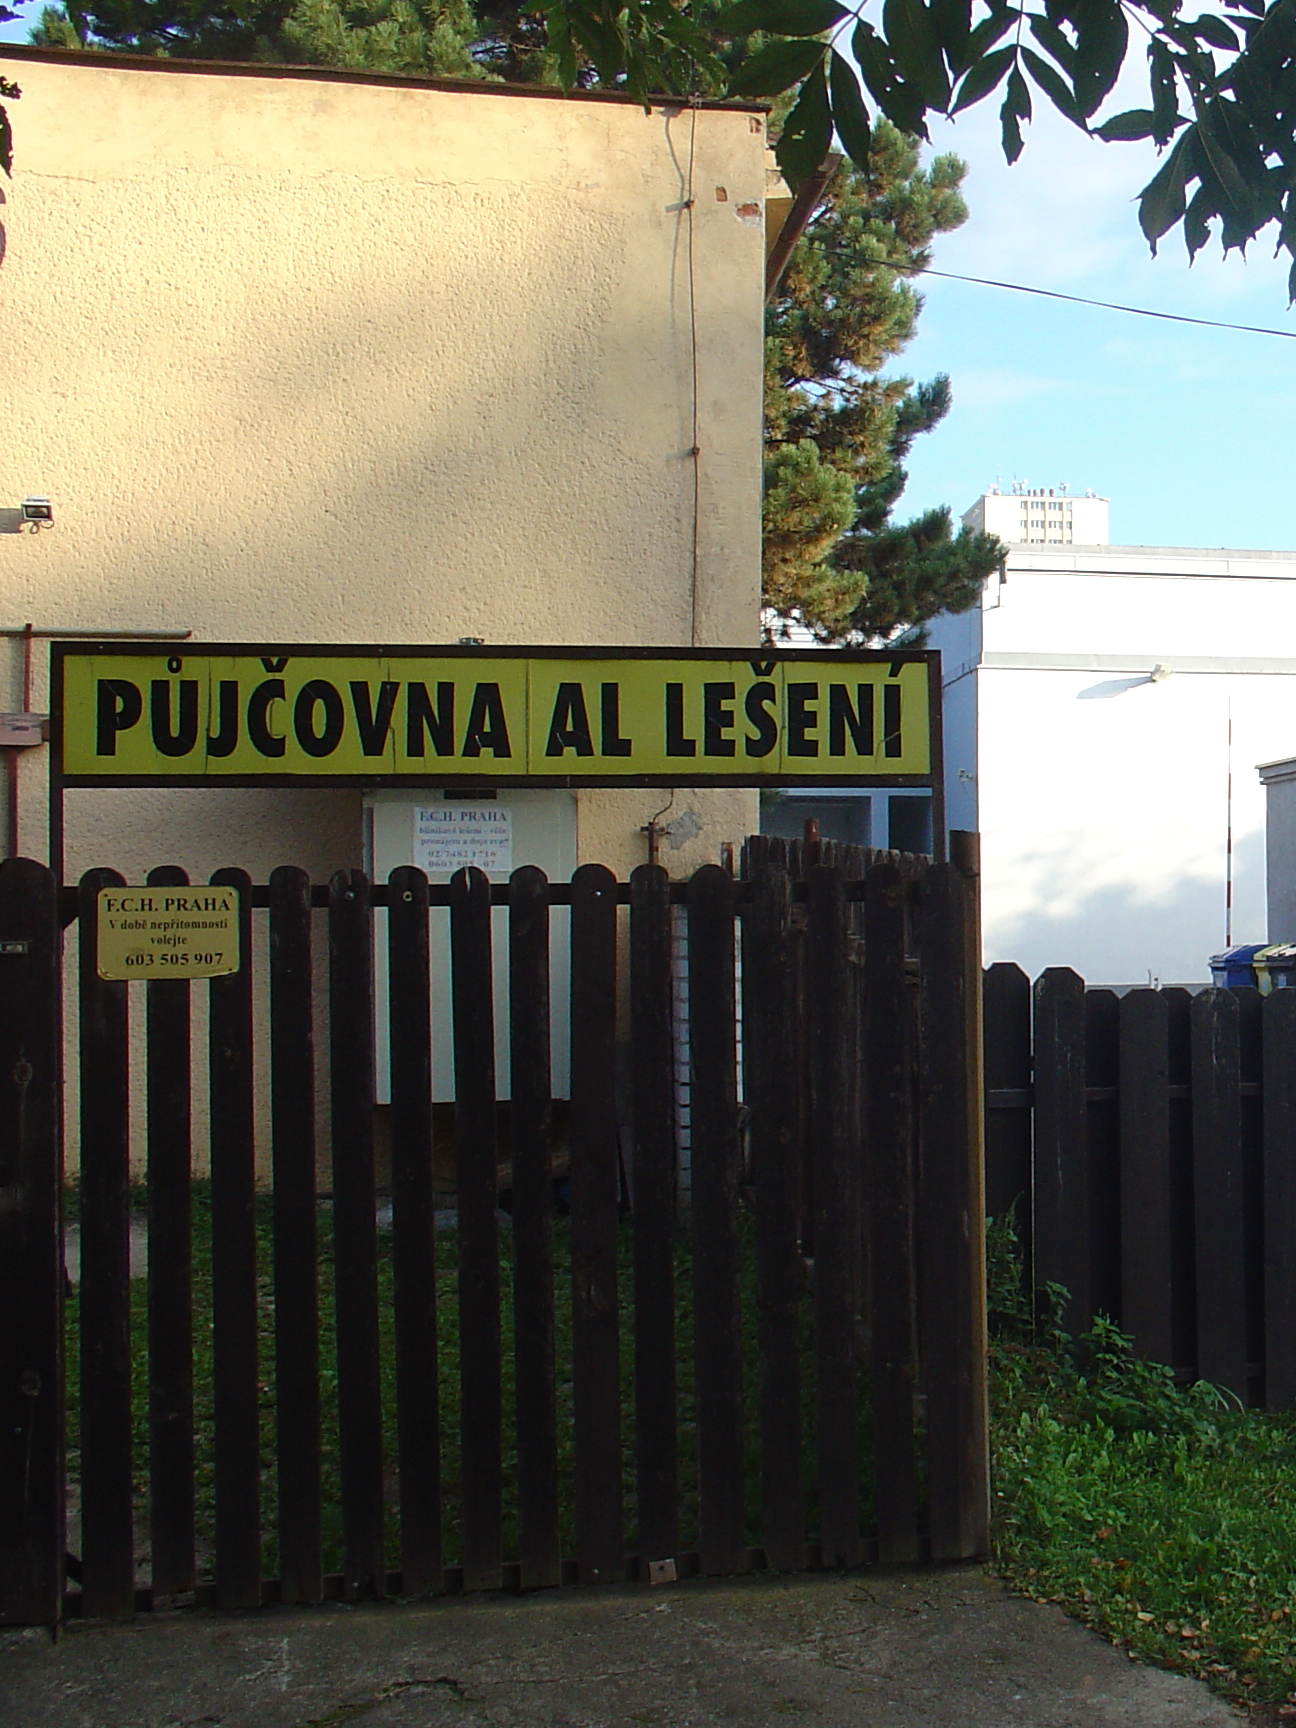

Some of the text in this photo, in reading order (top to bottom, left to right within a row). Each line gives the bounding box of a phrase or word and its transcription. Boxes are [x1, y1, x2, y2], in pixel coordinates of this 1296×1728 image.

[95, 656, 902, 758] PŮJČOVNA AL LEŠENÍ
[460, 811, 507, 822] PRAHA
[106, 897, 231, 912] F.C.H. PRAHA
[109, 919, 118, 929] V
[120, 919, 147, 930] době
[150, 934, 187, 947] volejte
[125, 952, 223, 966] 603 505 907
